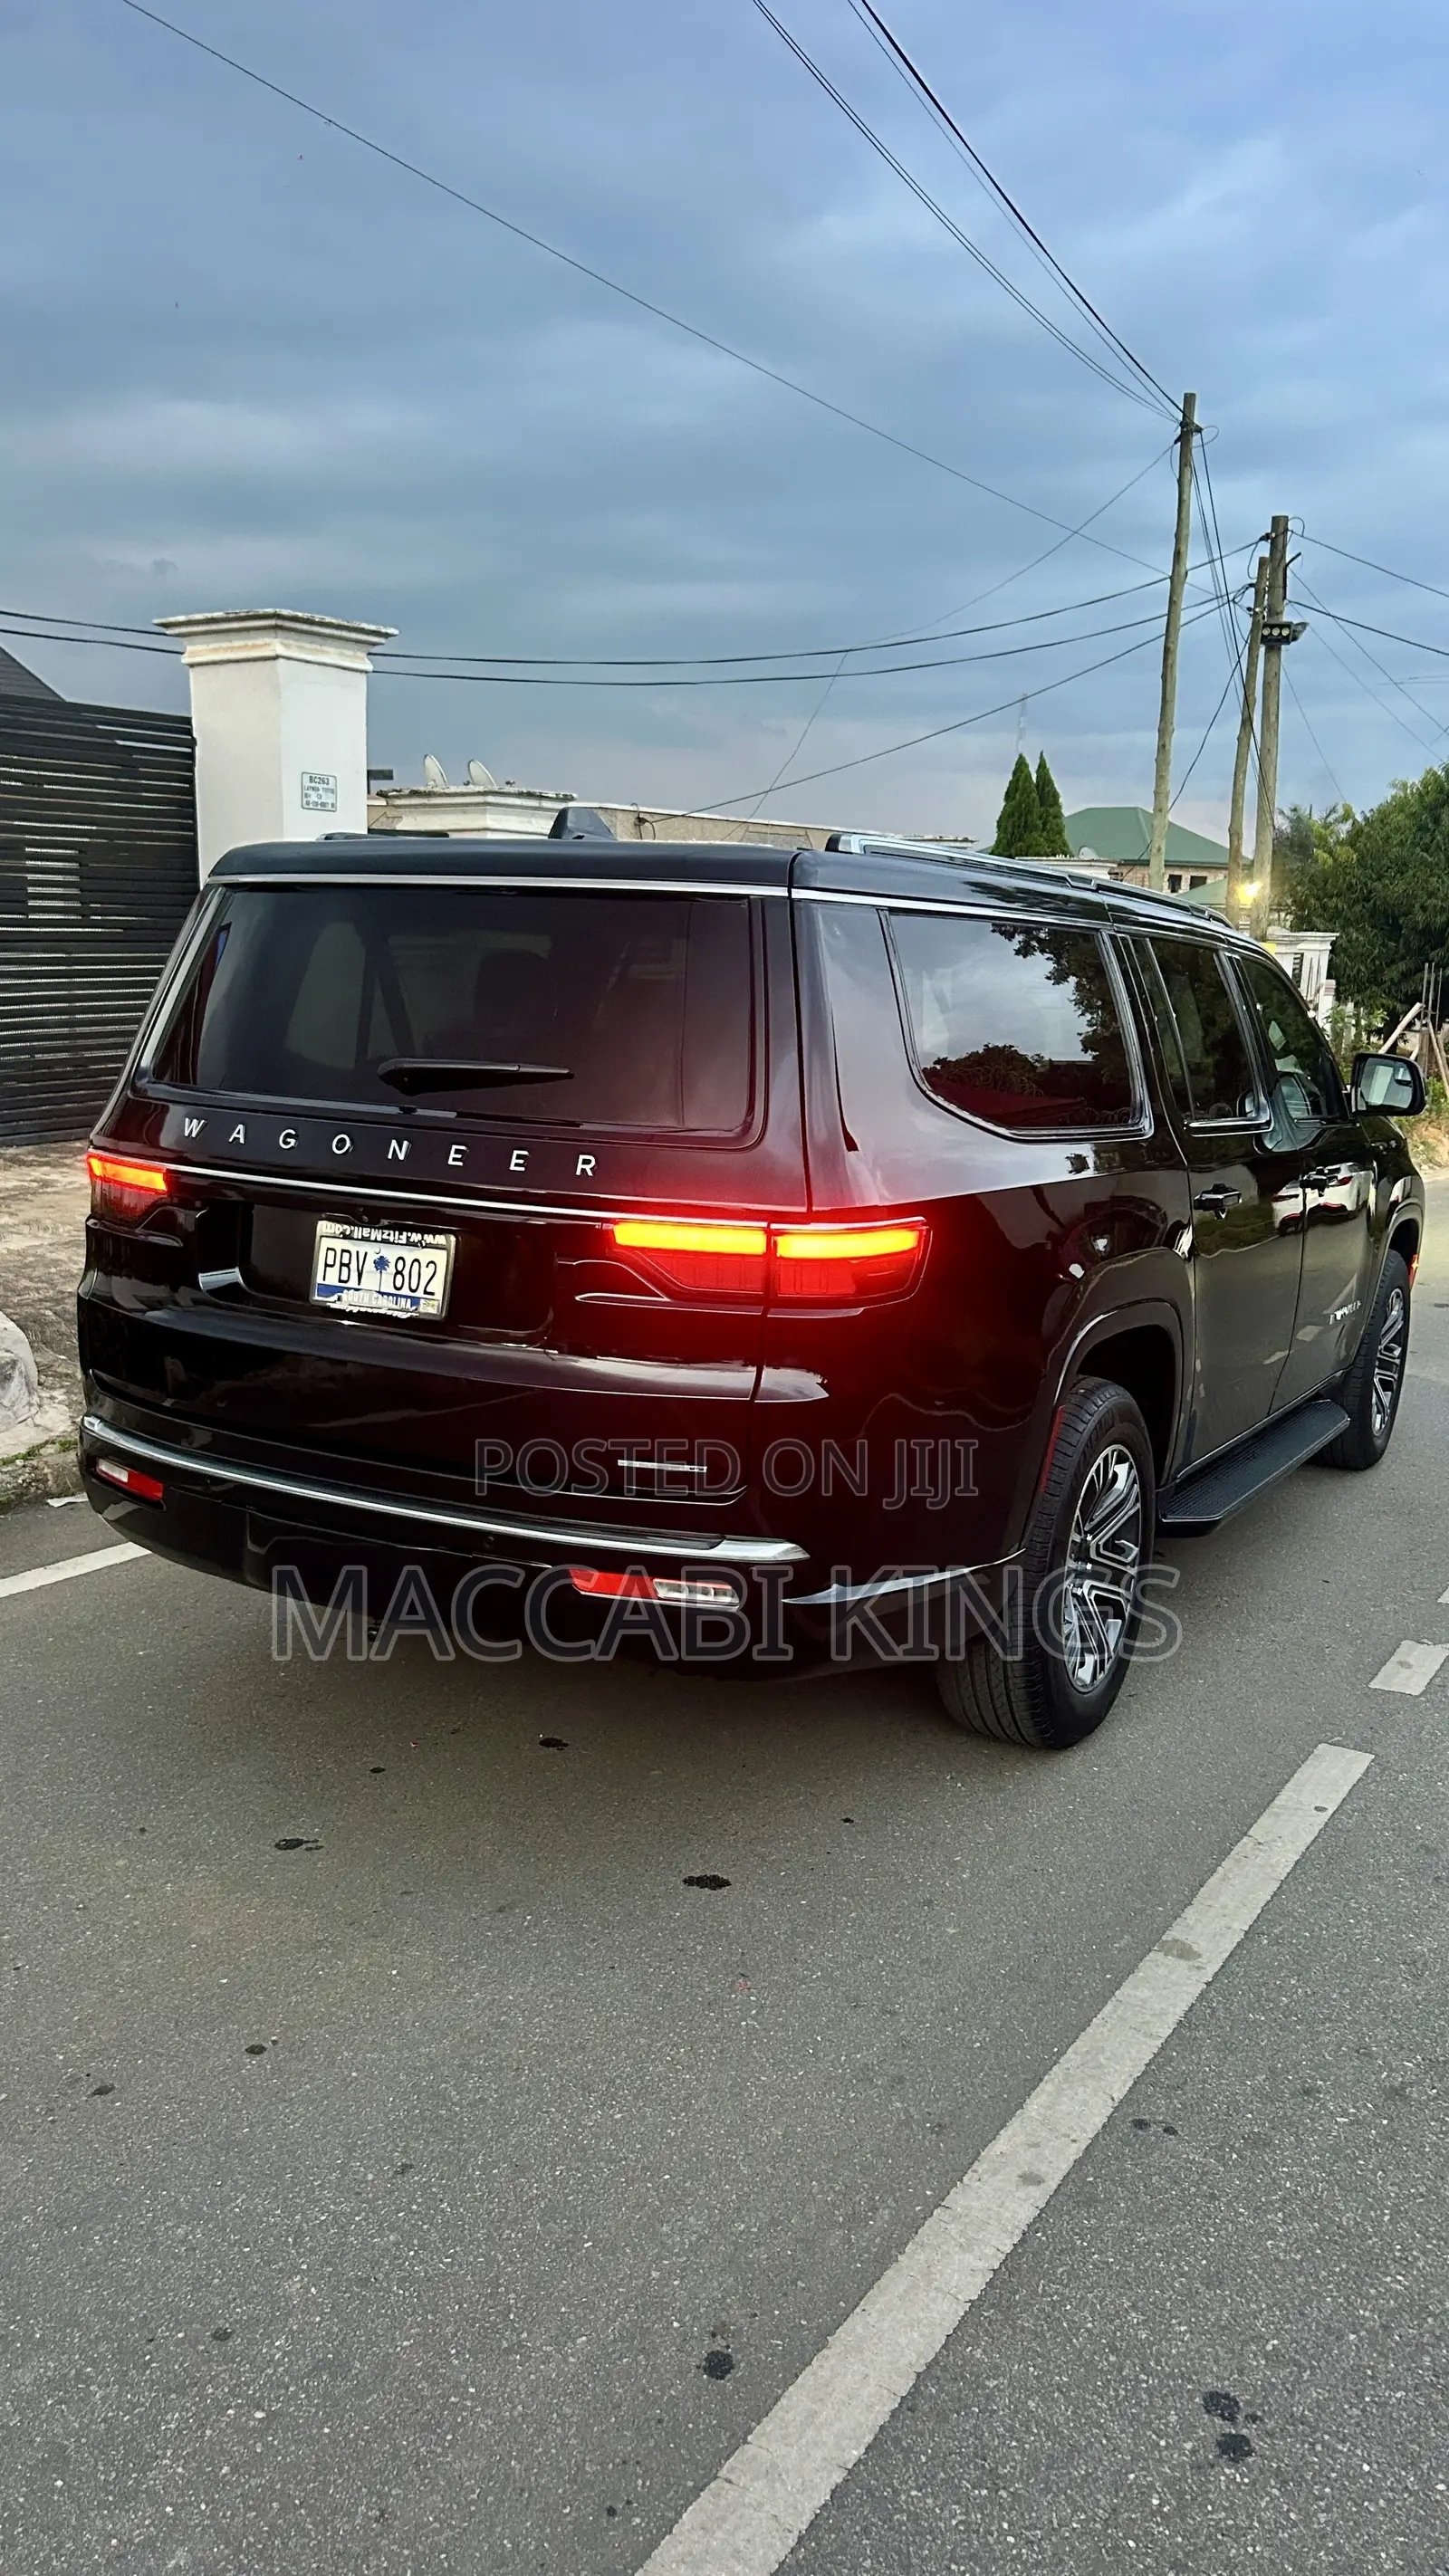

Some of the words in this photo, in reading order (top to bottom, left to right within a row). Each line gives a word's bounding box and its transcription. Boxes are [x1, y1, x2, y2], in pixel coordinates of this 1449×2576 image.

[183, 1117, 596, 1176] WAGONEER
[322, 1247, 368, 1287] PBV
[392, 1256, 437, 1297] 802
[341, 1289, 370, 1306] SOUTH
[371, 1292, 412, 1310] CAROLINA
